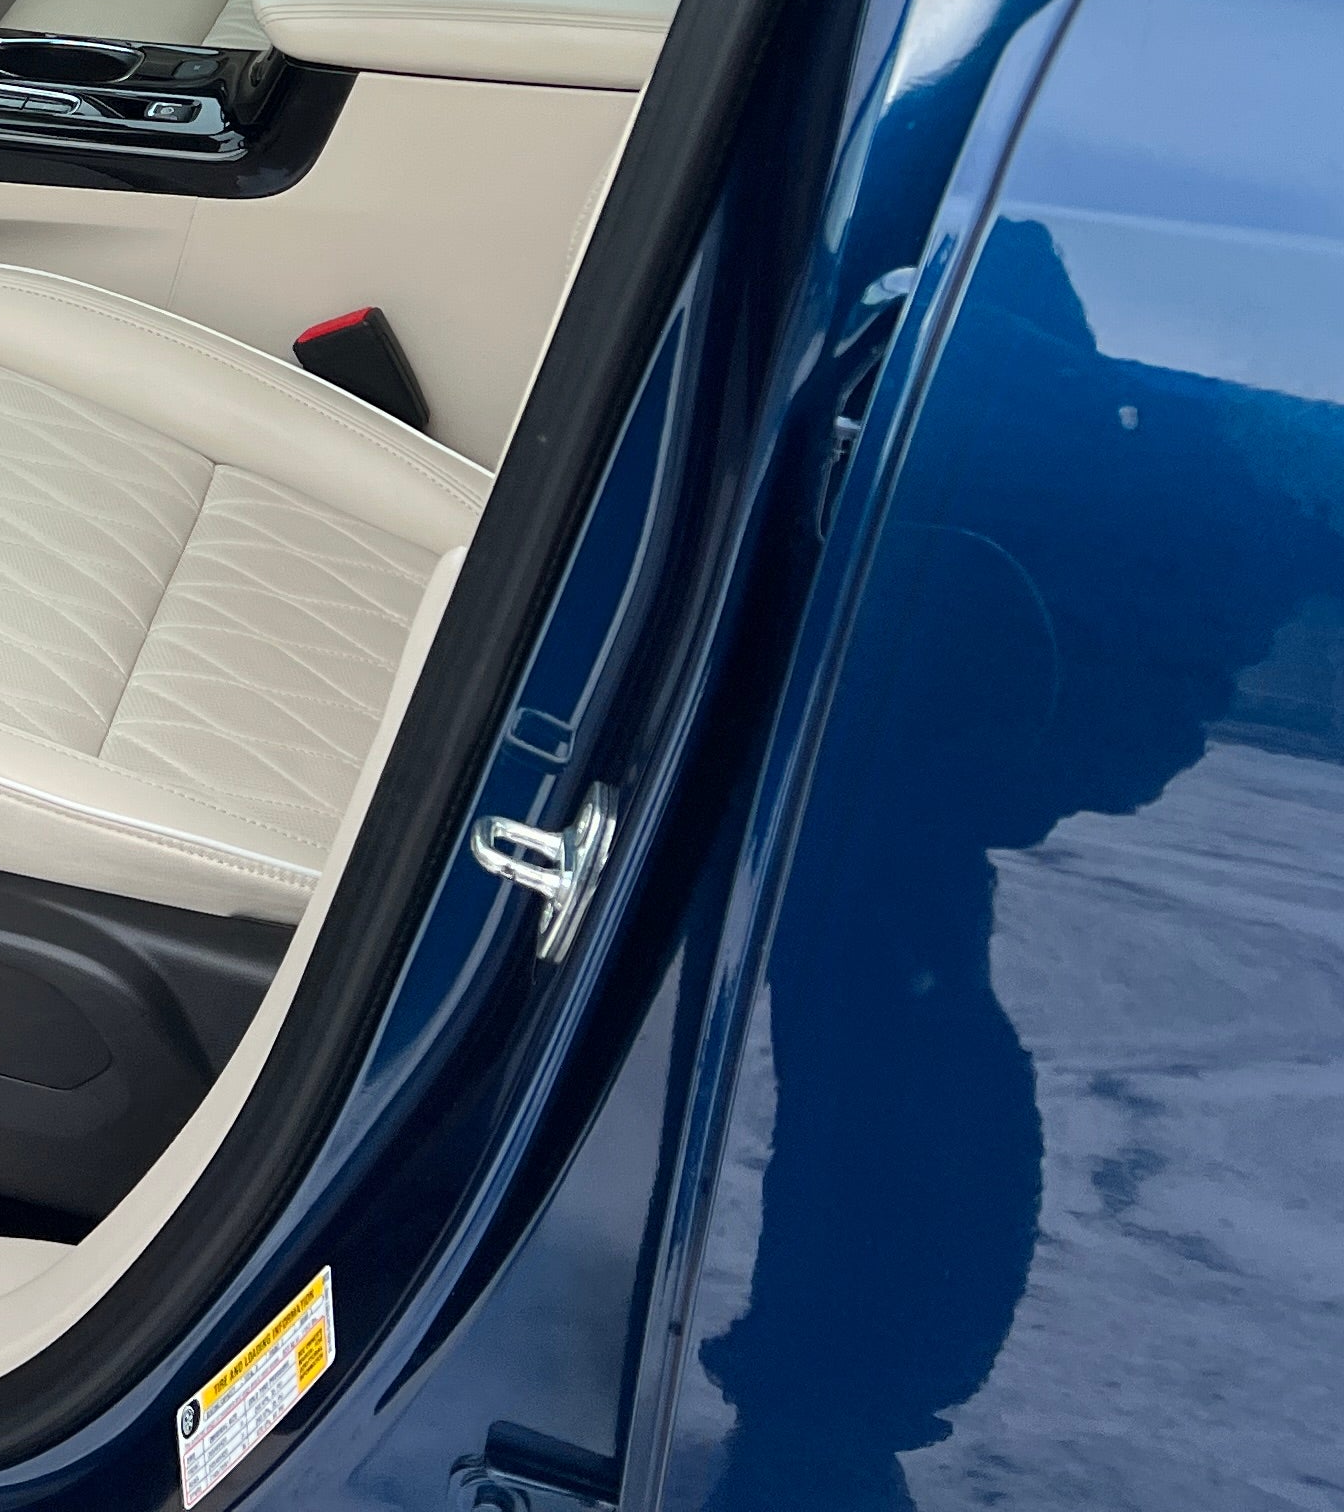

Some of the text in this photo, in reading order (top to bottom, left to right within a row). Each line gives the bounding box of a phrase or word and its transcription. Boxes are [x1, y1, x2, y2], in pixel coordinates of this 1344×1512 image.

[213, 1374, 228, 1395] TIRE
[229, 1360, 244, 1381] AND
[244, 1332, 271, 1367] LOADING
[272, 1289, 315, 1339] INFORMATION
